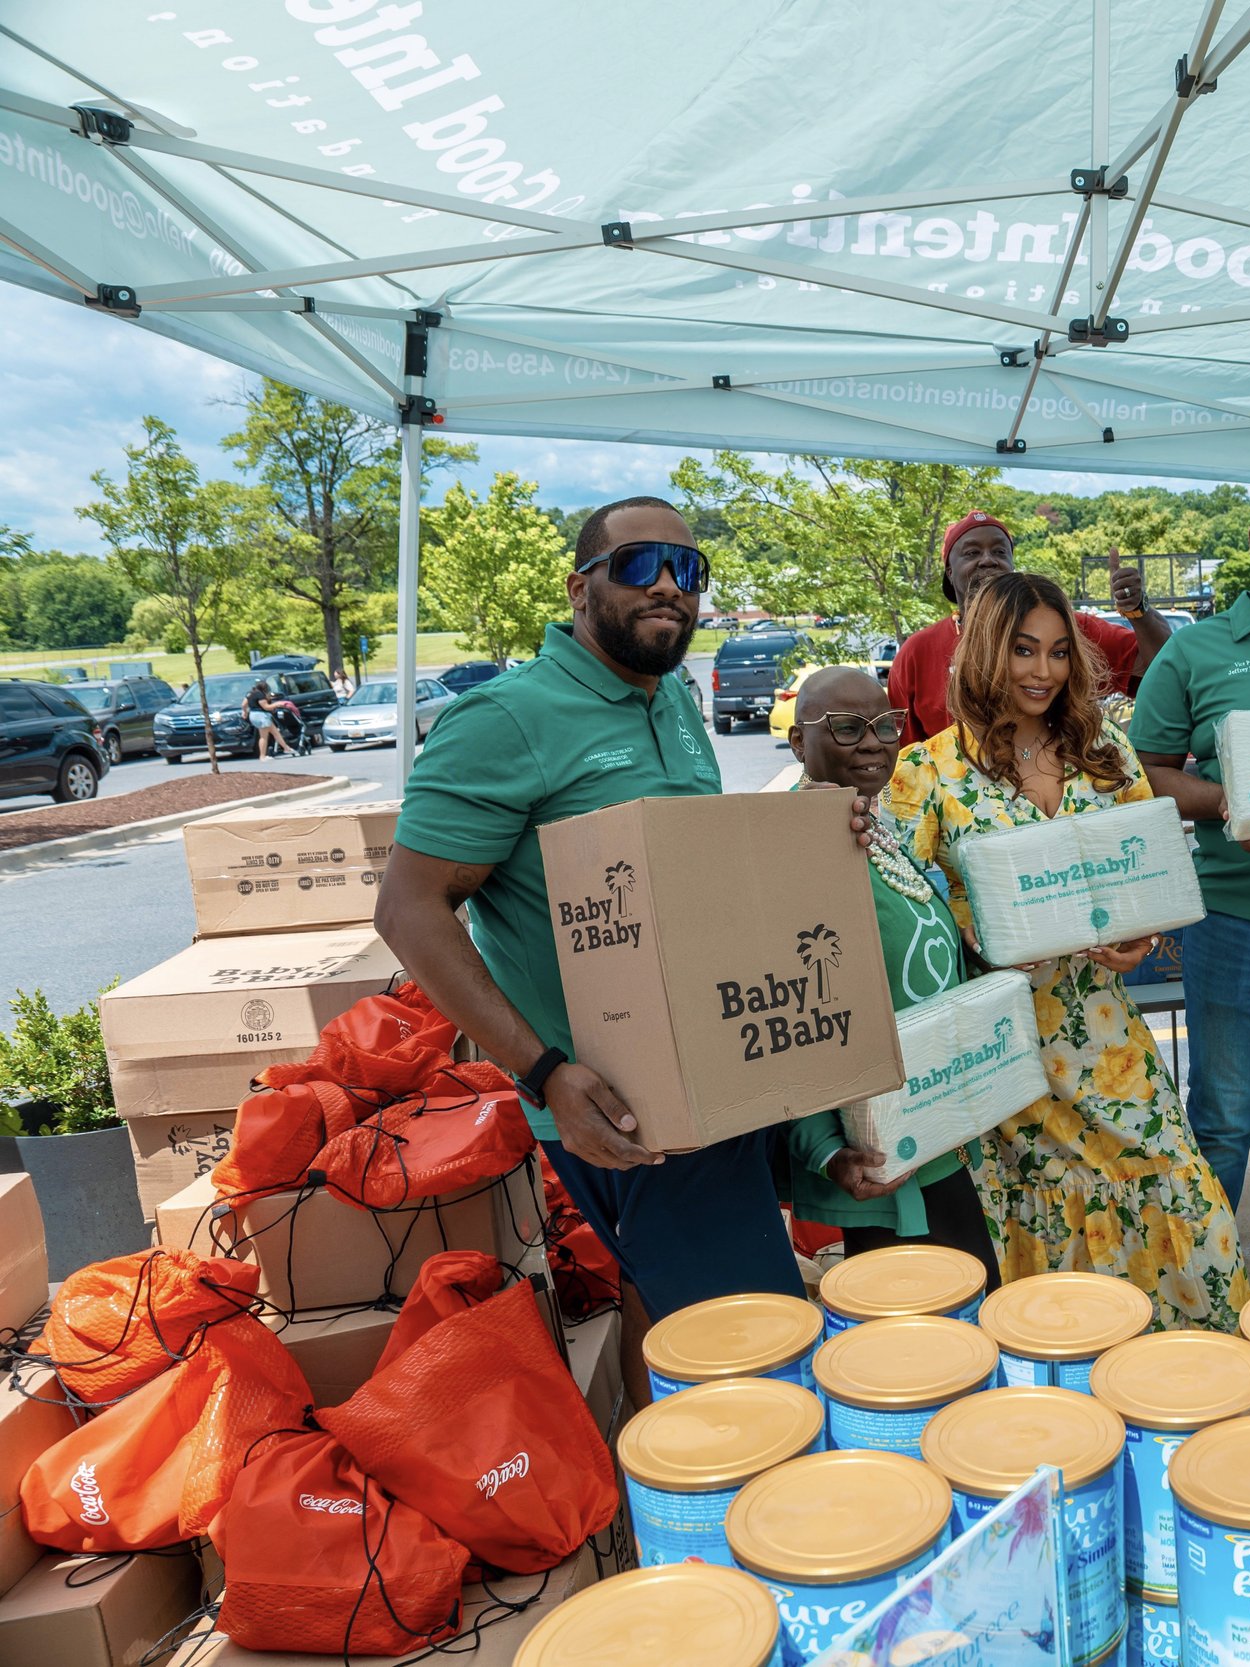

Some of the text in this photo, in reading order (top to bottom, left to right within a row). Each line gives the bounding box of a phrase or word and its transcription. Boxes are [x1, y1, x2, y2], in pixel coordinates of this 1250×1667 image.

[1017, 856, 1131, 892] Baby2Baby
[1013, 896, 1045, 908] Providing
[1058, 888, 1075, 899] basic
[1124, 874, 1140, 885] child
[558, 896, 613, 927] Baby
[209, 966, 314, 977] Baby
[716, 973, 809, 1021] Baby
[603, 1010, 631, 1023] Diapers
[907, 1041, 1000, 1097] Baby2Baby
[902, 1098, 932, 1116] Providing
[1231, 1632, 1248, 1643] No
